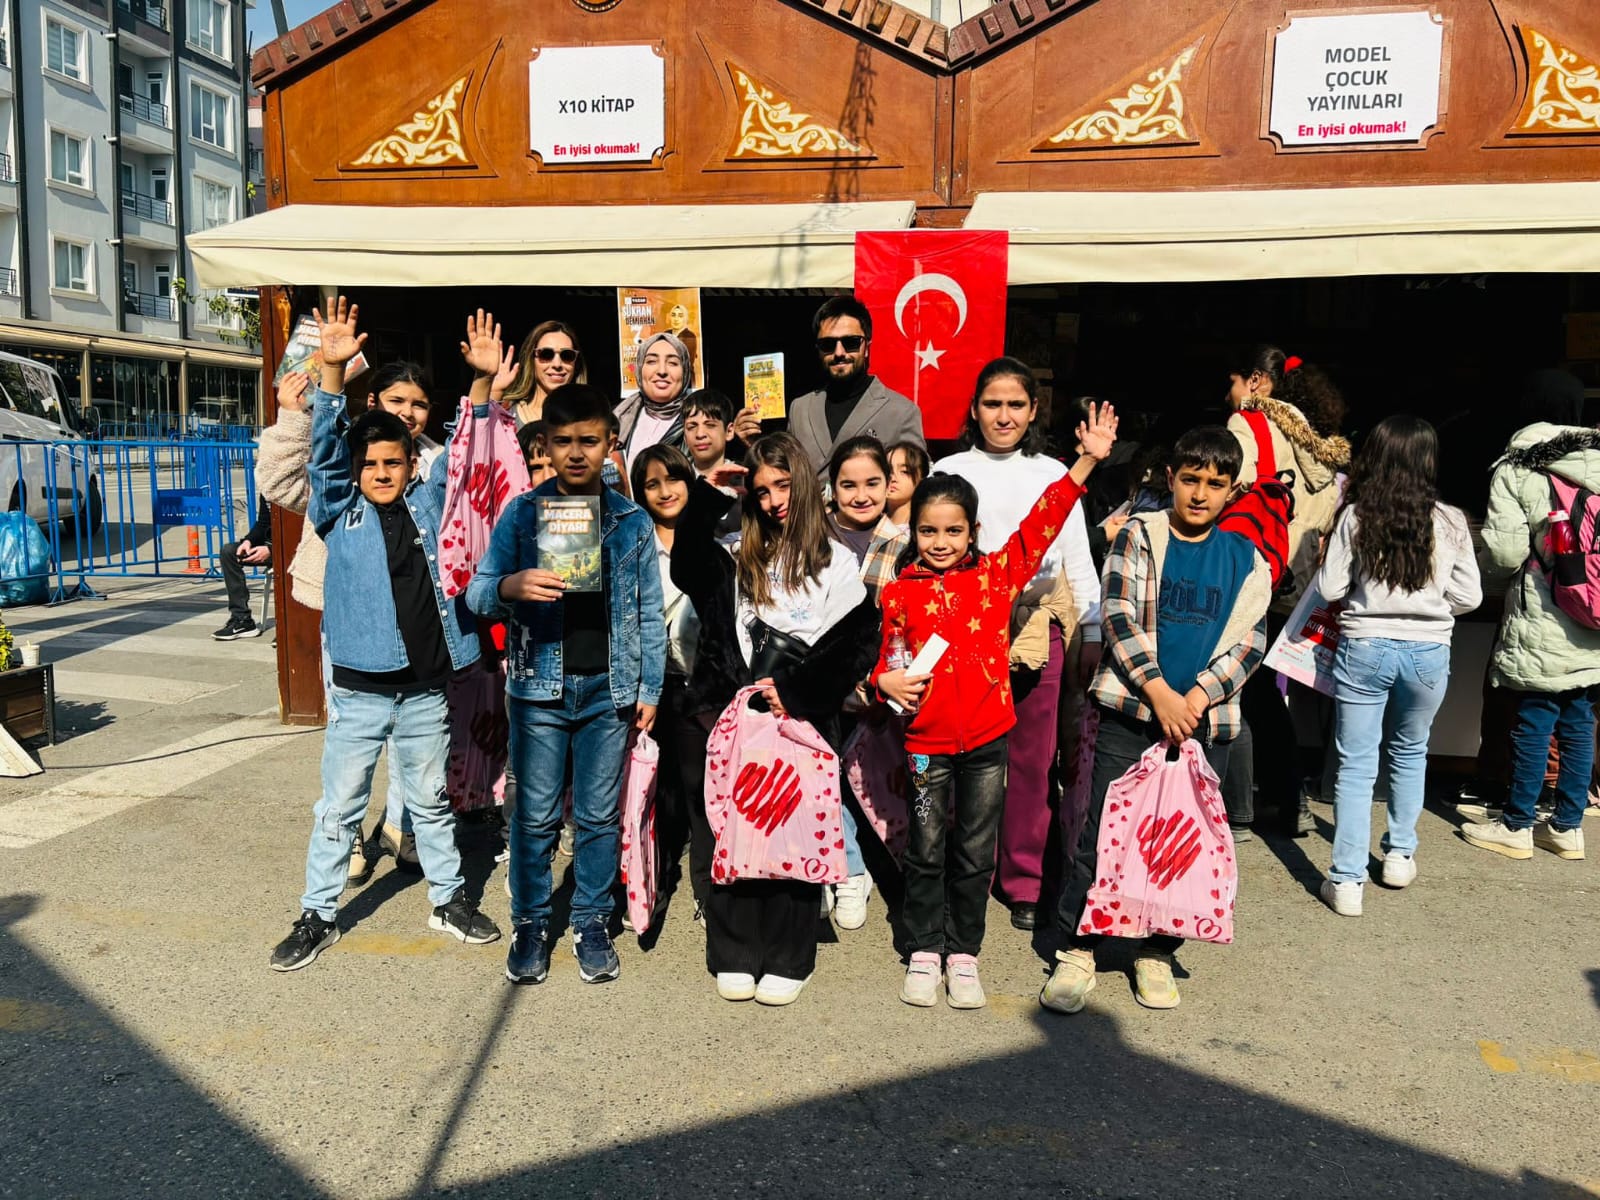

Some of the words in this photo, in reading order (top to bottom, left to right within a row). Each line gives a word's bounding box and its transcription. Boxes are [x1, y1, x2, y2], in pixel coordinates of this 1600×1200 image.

[1325, 47, 1391, 63] MODEL
[1325, 70, 1388, 91] ÇOCUK
[559, 100, 587, 113] X10
[592, 95, 635, 113] KİTAP
[1307, 93, 1402, 111] YAYINLARI
[1298, 125, 1314, 137] En
[1318, 123, 1345, 138] iyisi
[1349, 121, 1407, 134] okumak!
[554, 145, 567, 155] En
[570, 144, 591, 157] iyisi
[594, 143, 640, 155] okumak!
[544, 509, 593, 520] MACERA
